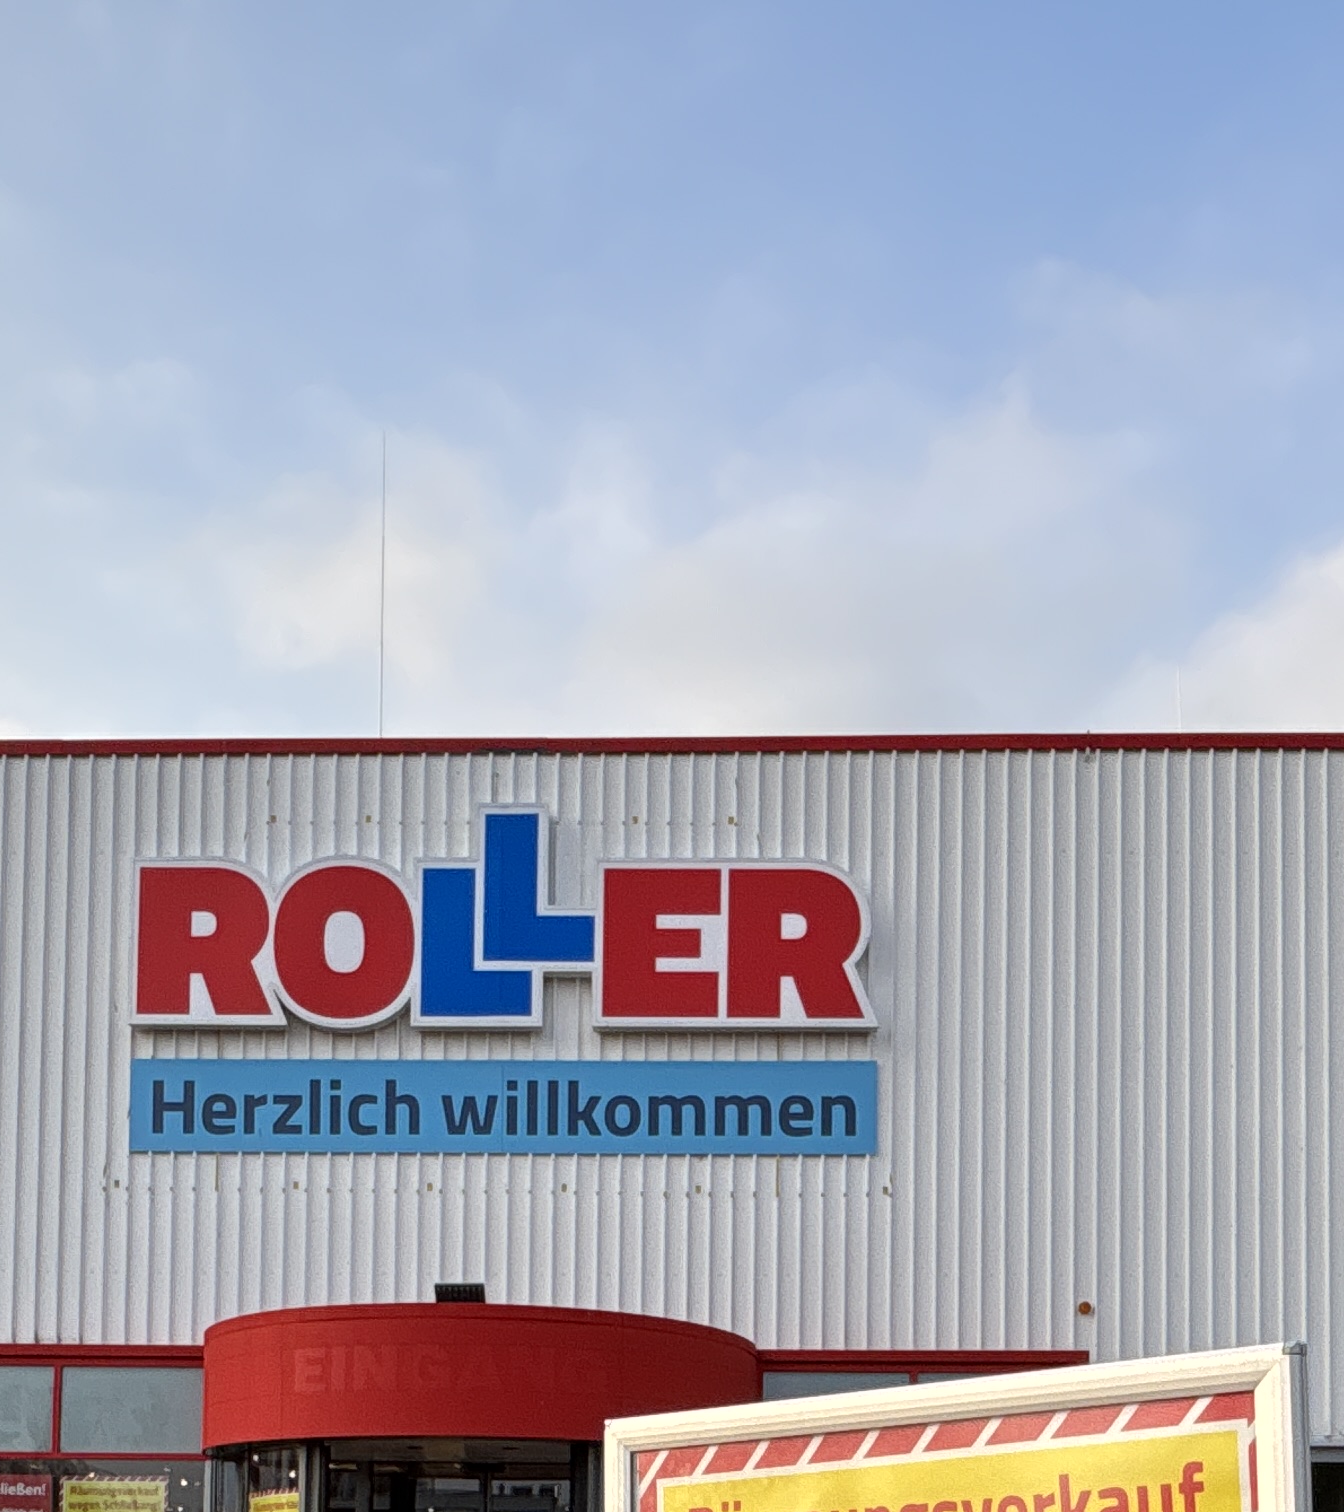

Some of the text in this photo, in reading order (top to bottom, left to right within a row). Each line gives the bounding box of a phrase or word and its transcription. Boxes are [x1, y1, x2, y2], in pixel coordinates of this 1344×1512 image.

[135, 812, 866, 1020] ROLLER
[151, 1079, 858, 1139] Herzlich willkommen
